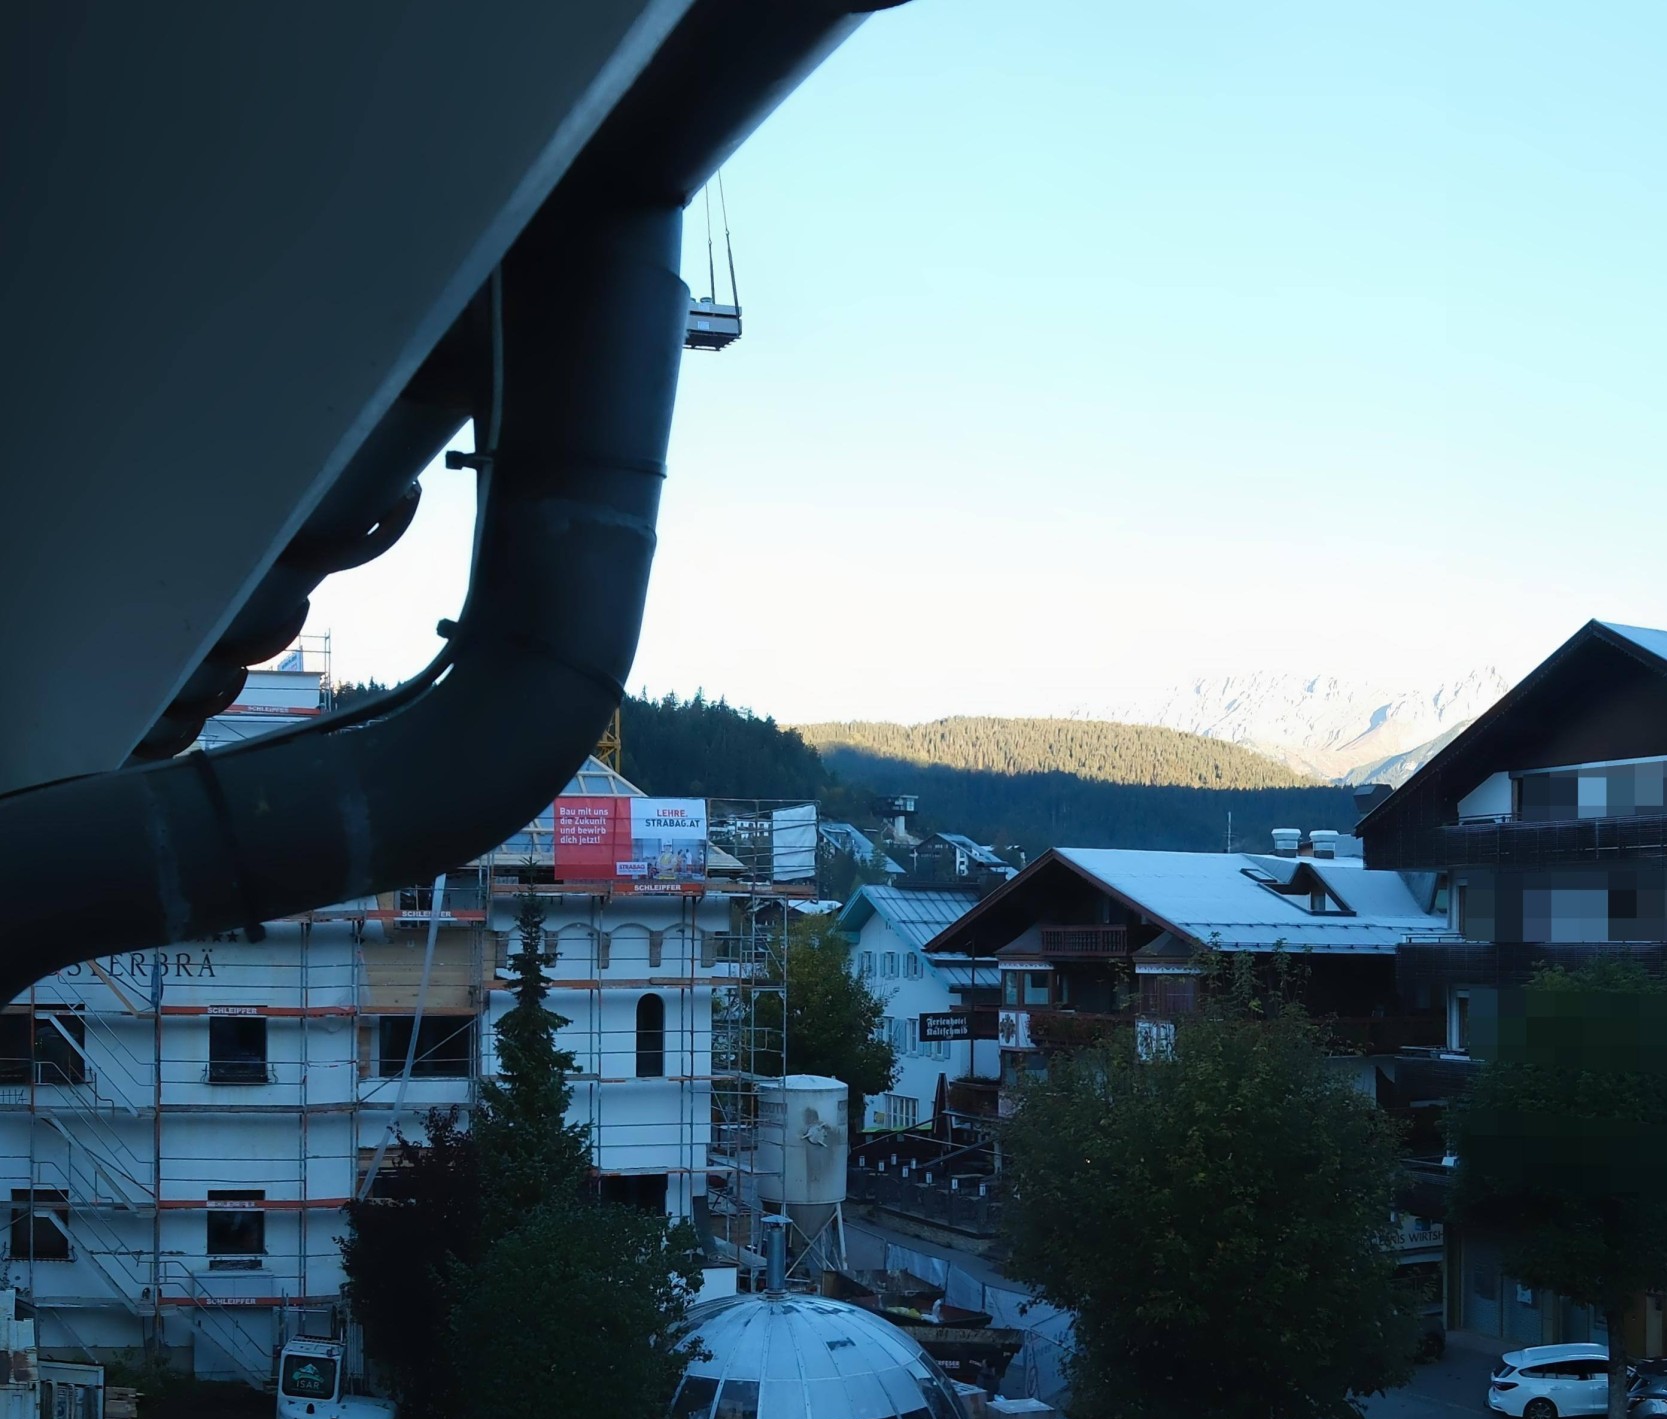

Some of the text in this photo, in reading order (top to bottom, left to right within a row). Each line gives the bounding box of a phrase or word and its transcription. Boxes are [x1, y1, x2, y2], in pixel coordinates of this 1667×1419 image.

[560, 807, 609, 816] Bau mit uns
[656, 809, 688, 818] LEHRE.
[560, 817, 606, 825] die Zukunft
[645, 819, 700, 828] STRABAG.AT
[560, 826, 607, 835] und bewirb
[560, 835, 601, 845] dich jetzt!
[634, 884, 681, 892] SCHLEIPFER
[207, 1007, 257, 1015] SCHLEIPFER
[296, 1380, 320, 1389] ISAR
